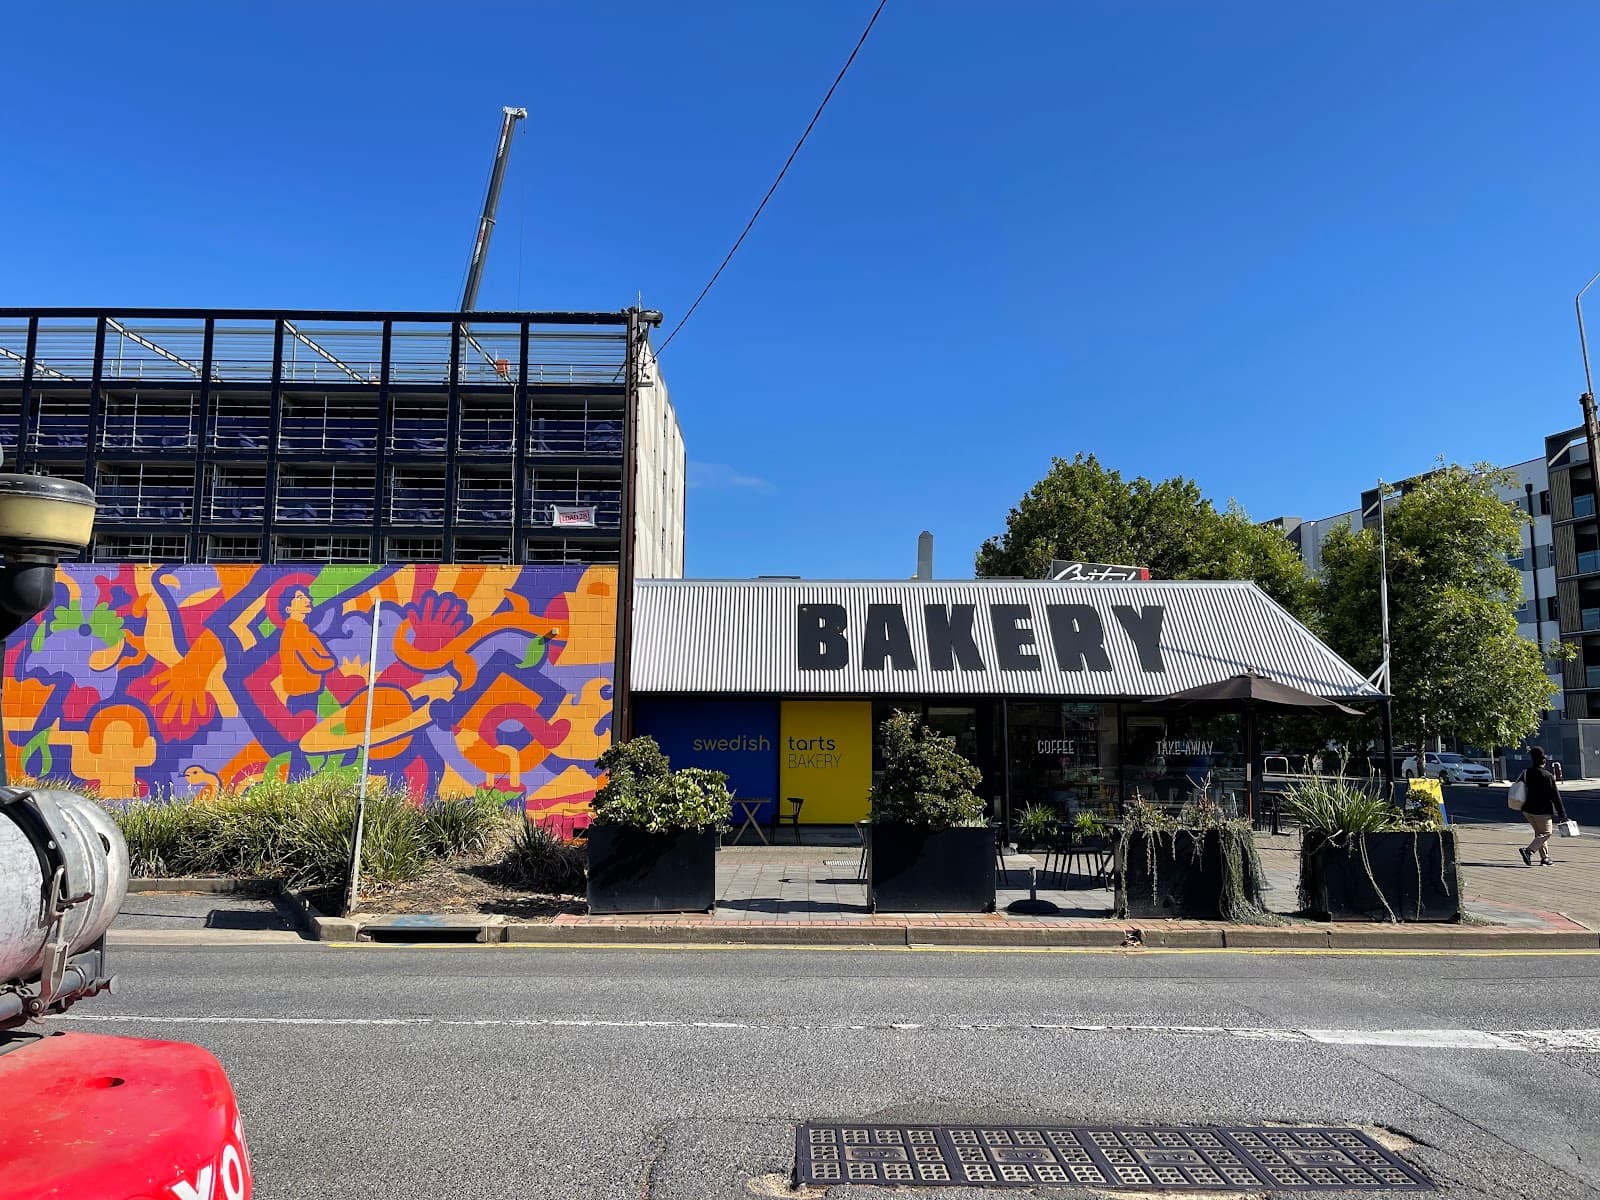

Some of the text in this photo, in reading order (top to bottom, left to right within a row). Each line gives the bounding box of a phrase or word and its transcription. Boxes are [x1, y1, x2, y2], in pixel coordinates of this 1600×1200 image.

[798, 603, 1165, 672] BAKERY
[693, 735, 836, 751] swedish tarts
[1037, 740, 1075, 755] COFFEE
[788, 753, 842, 769] BAKERY
